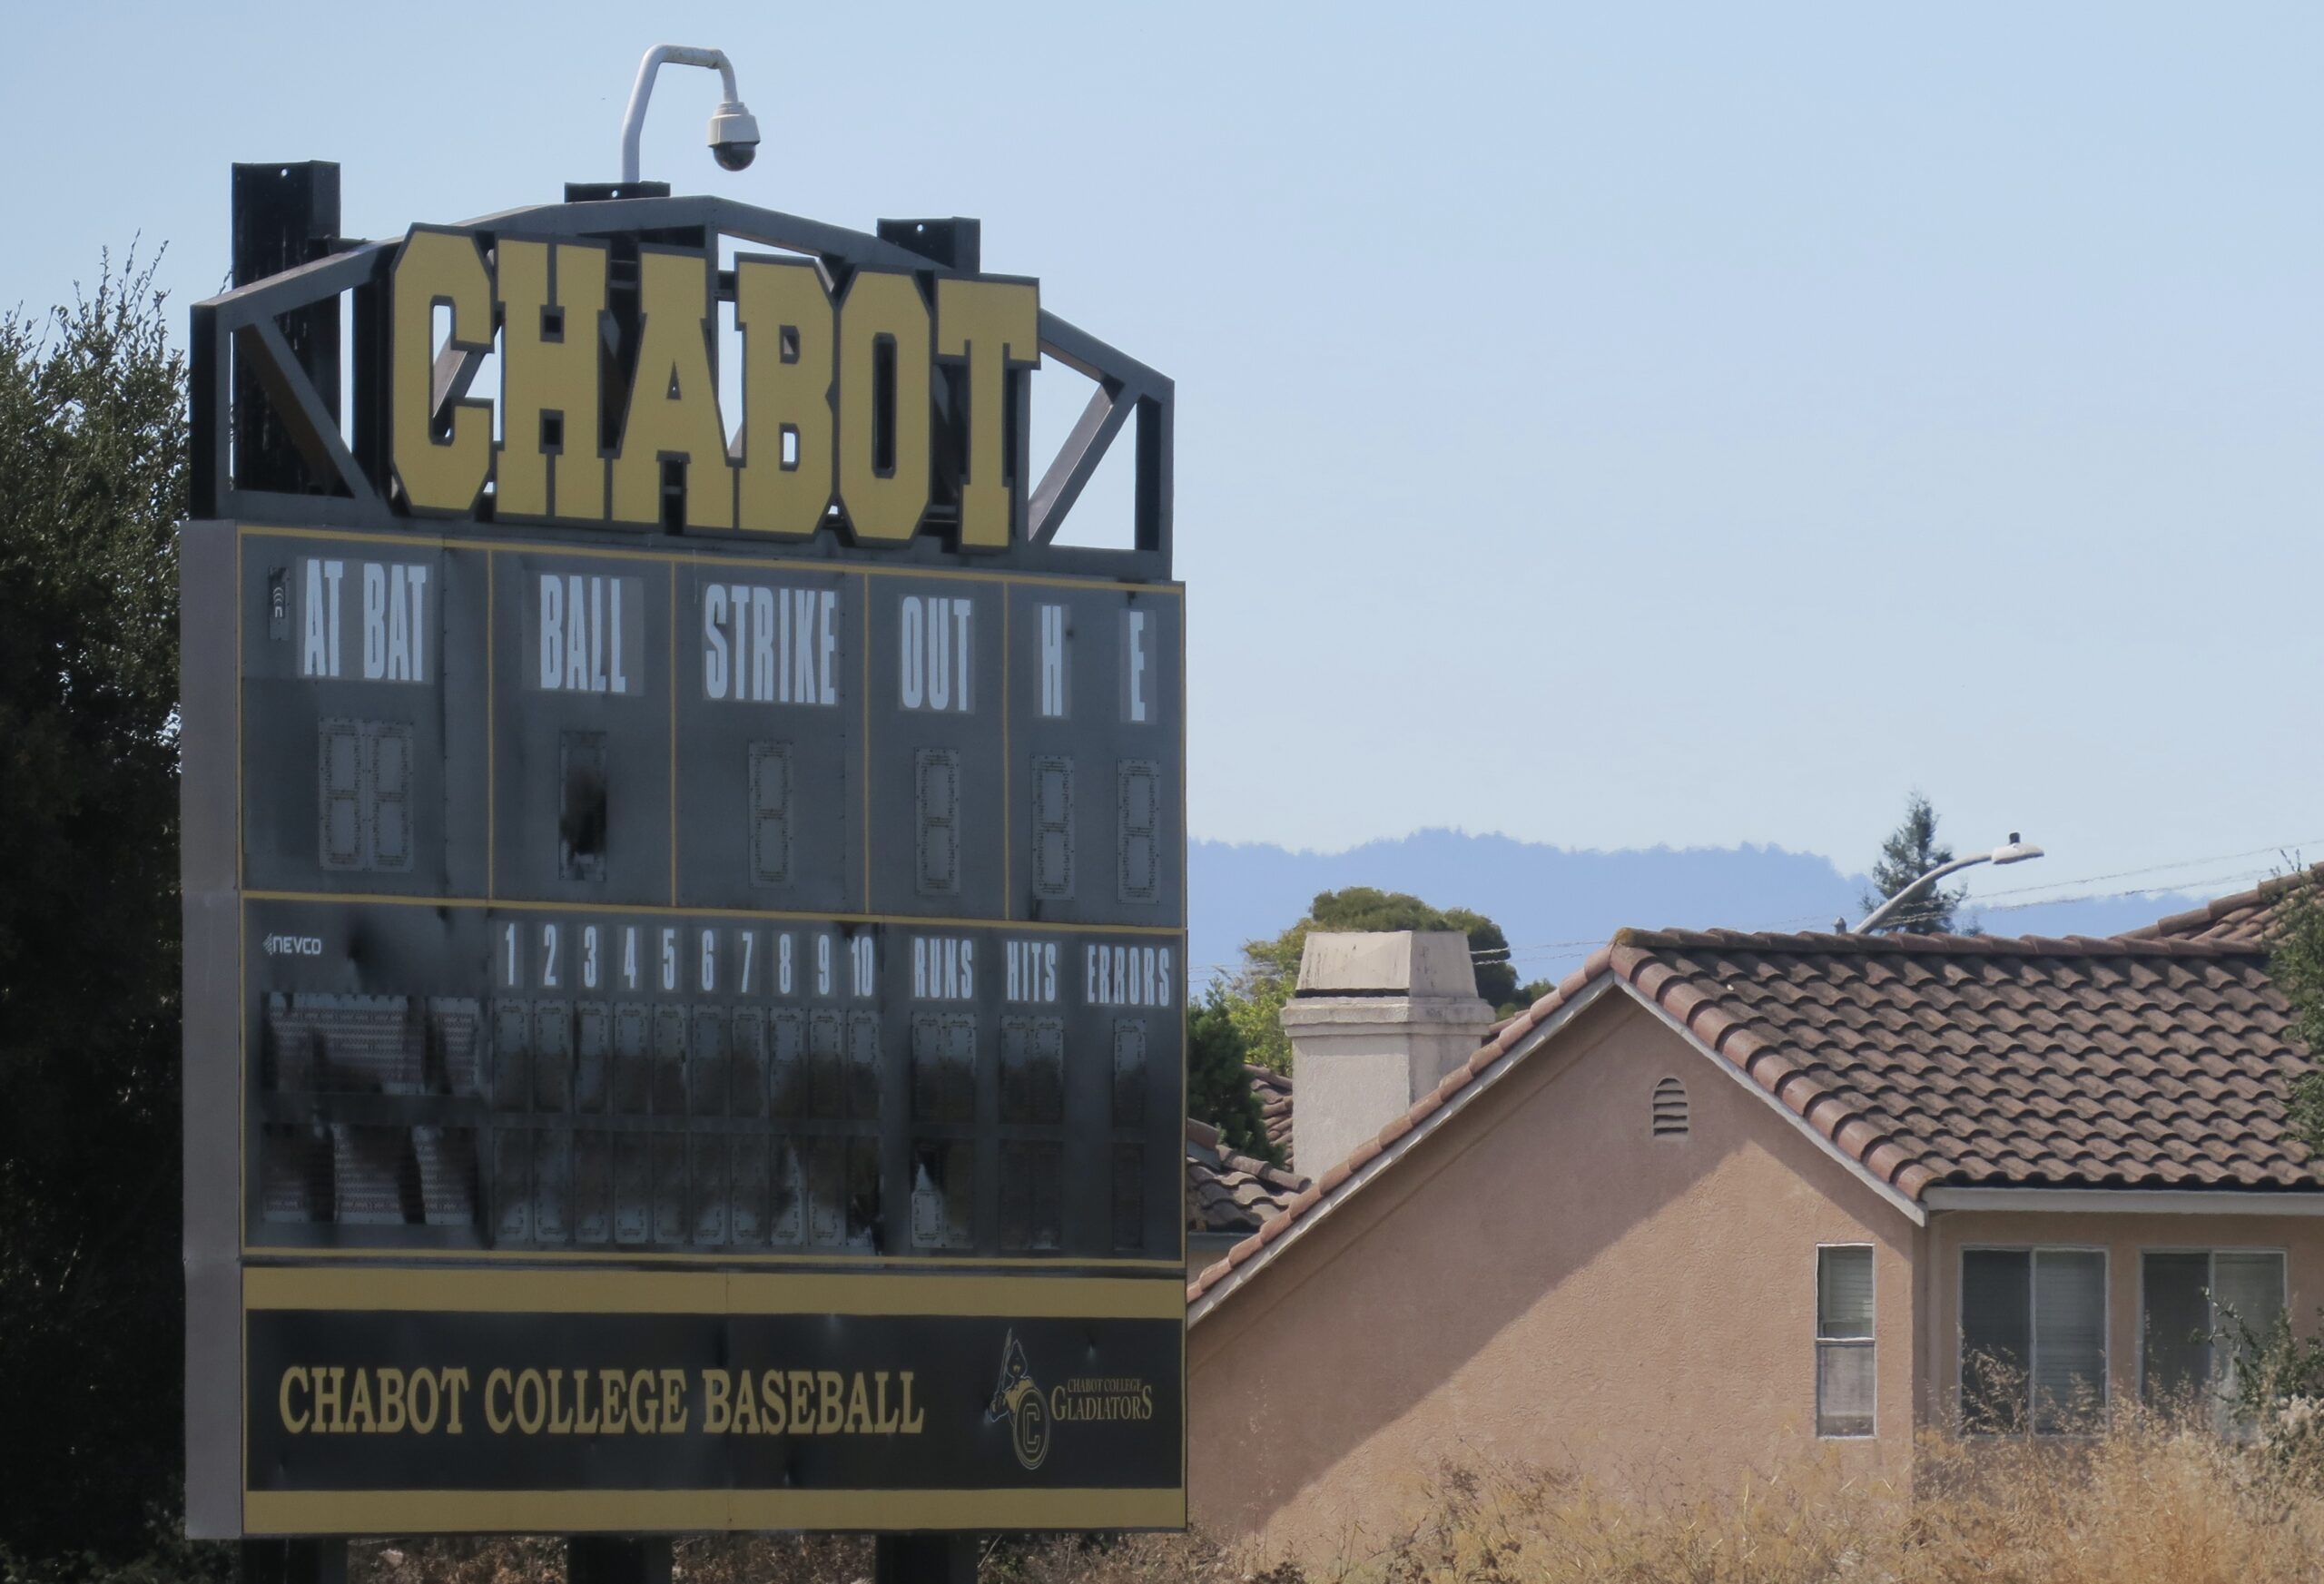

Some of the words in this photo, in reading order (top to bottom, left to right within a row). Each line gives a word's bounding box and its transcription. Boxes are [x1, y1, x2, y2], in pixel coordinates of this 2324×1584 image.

[390, 223, 1040, 549] CHABOT
[303, 558, 343, 677] AT
[363, 562, 427, 683] BAT
[539, 574, 626, 694] BALL
[704, 583, 837, 706] STRIKE
[901, 595, 971, 713] OUT
[1041, 604, 1062, 717] H
[1128, 610, 1146, 722] E
[272, 935, 322, 956] NEVCO
[505, 922, 516, 987] 1
[544, 923, 557, 987] 2
[584, 925, 597, 989] 3
[624, 927, 637, 989] 4
[662, 928, 675, 990] 5
[701, 929, 714, 991] 6
[740, 931, 753, 994] 7
[778, 933, 792, 995] 8
[817, 934, 831, 996] 9
[850, 936, 873, 998] 10
[913, 937, 973, 999] RUNS
[1006, 940, 1057, 1003] HITS
[1086, 944, 1170, 1008] ERRORS
[278, 1365, 470, 1436] CHABOT
[483, 1366, 688, 1436] COLLEGE
[701, 1368, 926, 1437] BASEBALL
[1051, 1385, 1152, 1421] GLADIATORS
[1068, 1379, 1103, 1392] CHABOT
[1105, 1379, 1141, 1392] COLLEGE
